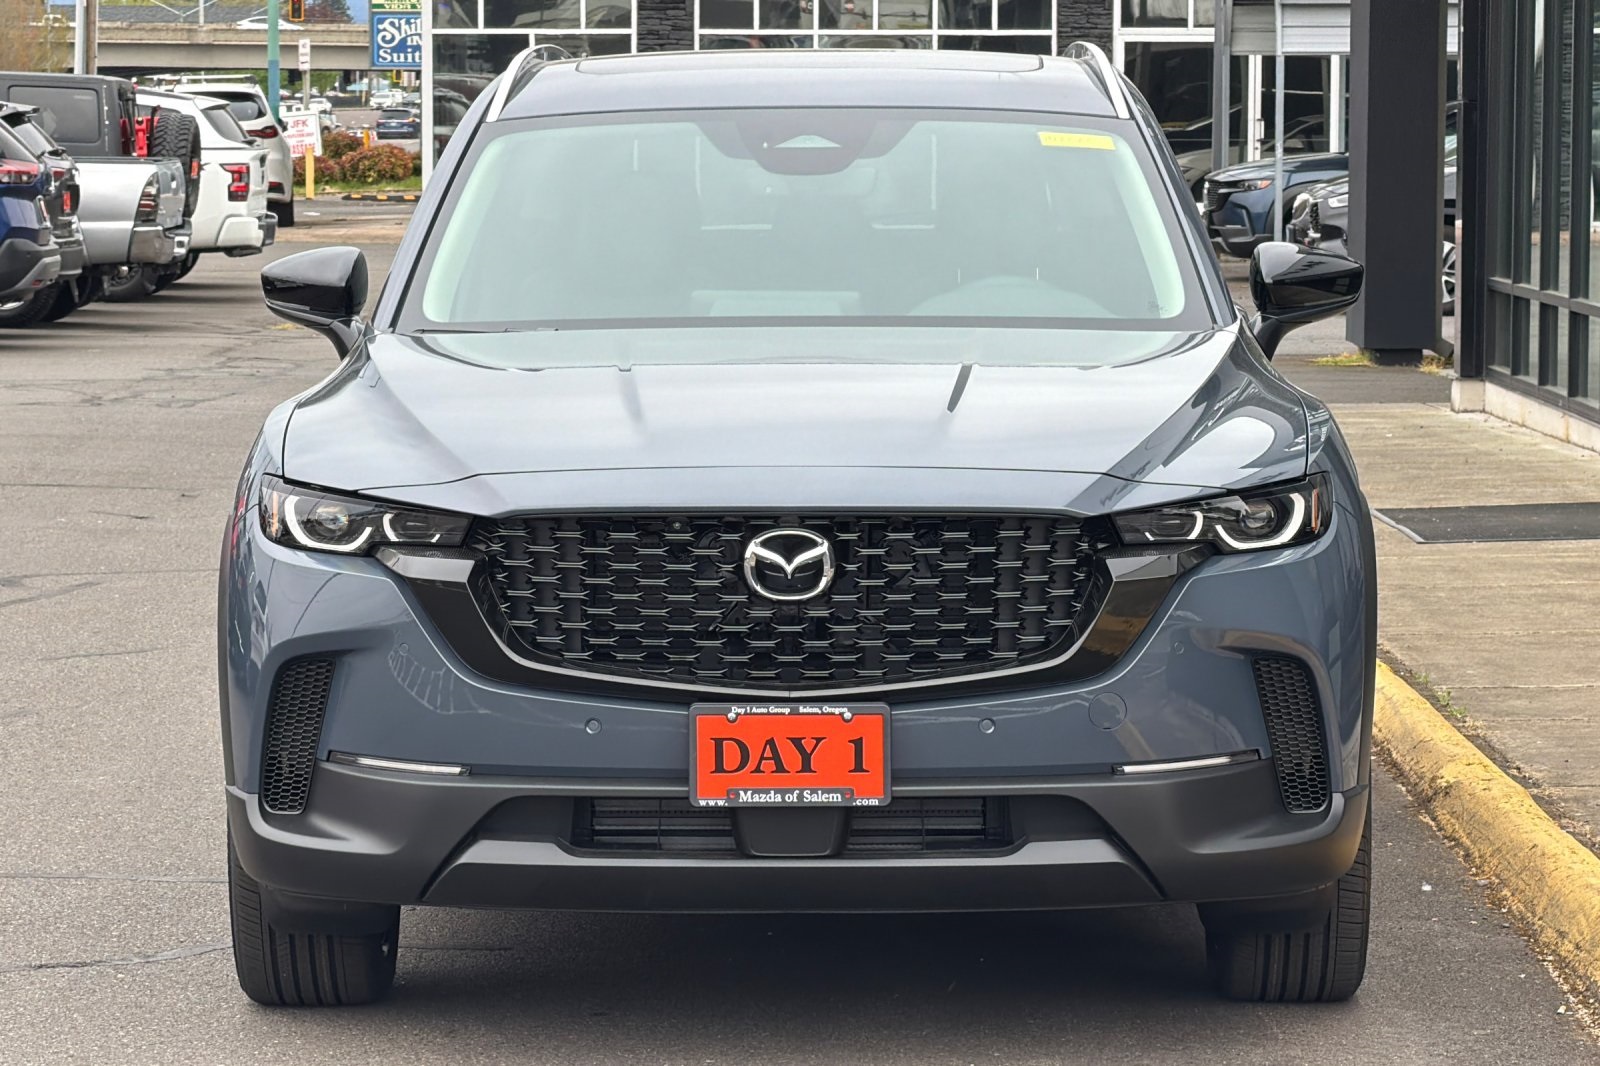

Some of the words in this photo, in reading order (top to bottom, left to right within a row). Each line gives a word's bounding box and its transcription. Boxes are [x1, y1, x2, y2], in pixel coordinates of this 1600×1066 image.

[377, 18, 422, 47] Shil
[406, 35, 422, 46] IN
[379, 48, 422, 63] Suit
[290, 119, 309, 128] JFK
[731, 706, 746, 714] Day
[769, 706, 791, 715] Group
[799, 706, 821, 714] Salem,
[822, 706, 849, 714] Oregon
[710, 736, 827, 774] DAY
[848, 736, 870, 774] 1
[738, 790, 782, 802] Mazda
[784, 789, 800, 802] of
[803, 790, 842, 802] Salem
[852, 798, 879, 806] .com
